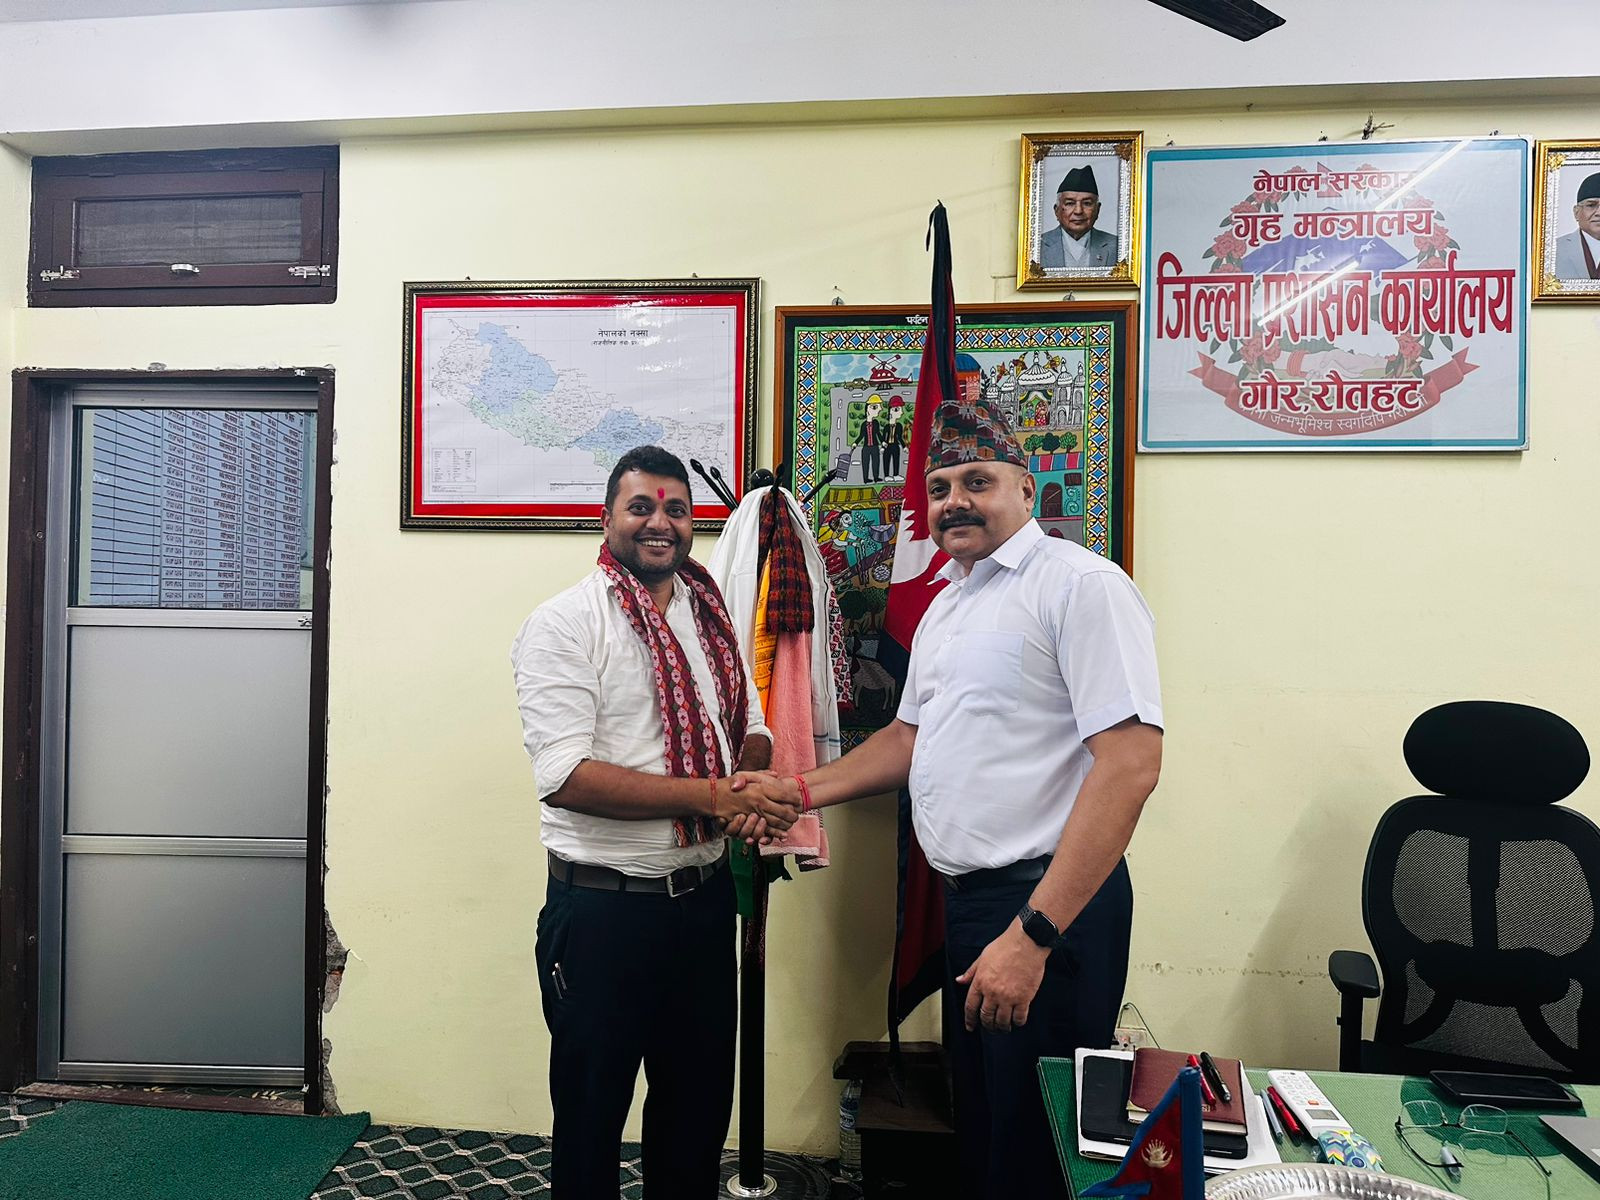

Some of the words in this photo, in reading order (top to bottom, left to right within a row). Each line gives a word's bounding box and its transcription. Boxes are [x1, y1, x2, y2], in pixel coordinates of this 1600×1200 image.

[1253, 169, 1322, 193] नेपाल
[1234, 214, 1284, 247] गृह
[1294, 210, 1434, 239] मन्त्रालय
[1156, 252, 1254, 342] जिल्ला
[1262, 270, 1373, 348] प्रशासन
[1380, 250, 1516, 339] कार्यालय
[598, 328, 627, 337] नेपालको
